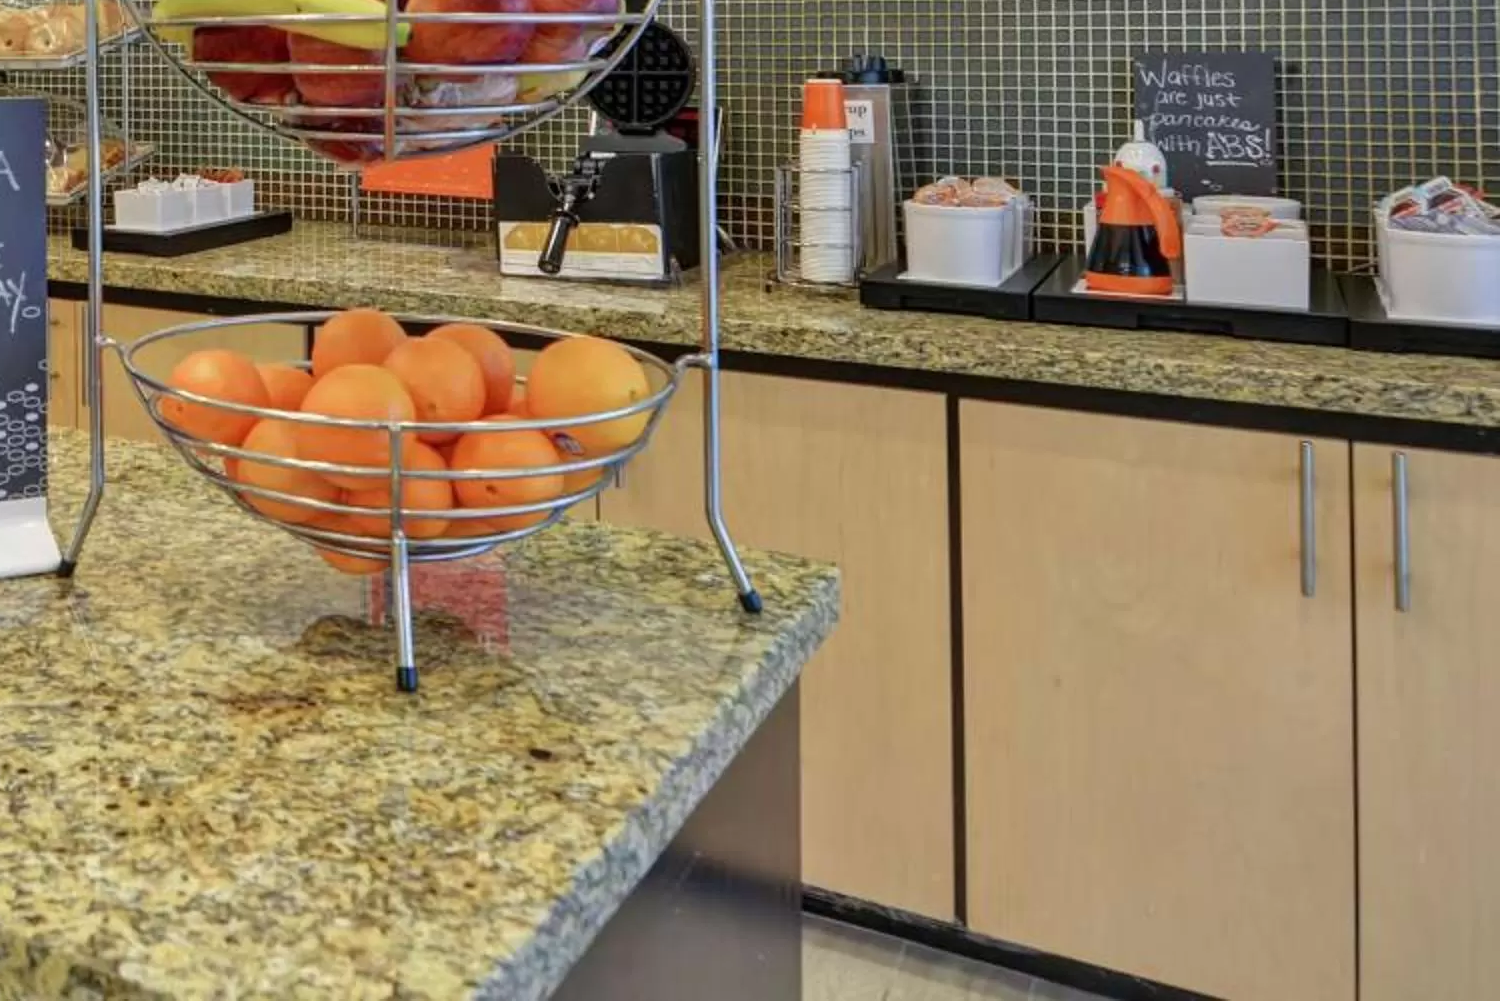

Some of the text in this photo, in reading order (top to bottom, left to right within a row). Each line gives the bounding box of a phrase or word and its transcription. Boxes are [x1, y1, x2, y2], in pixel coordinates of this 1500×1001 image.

[1135, 58, 1237, 89] Waffles
[1156, 90, 1243, 110] are just
[1153, 133, 1200, 156] with
